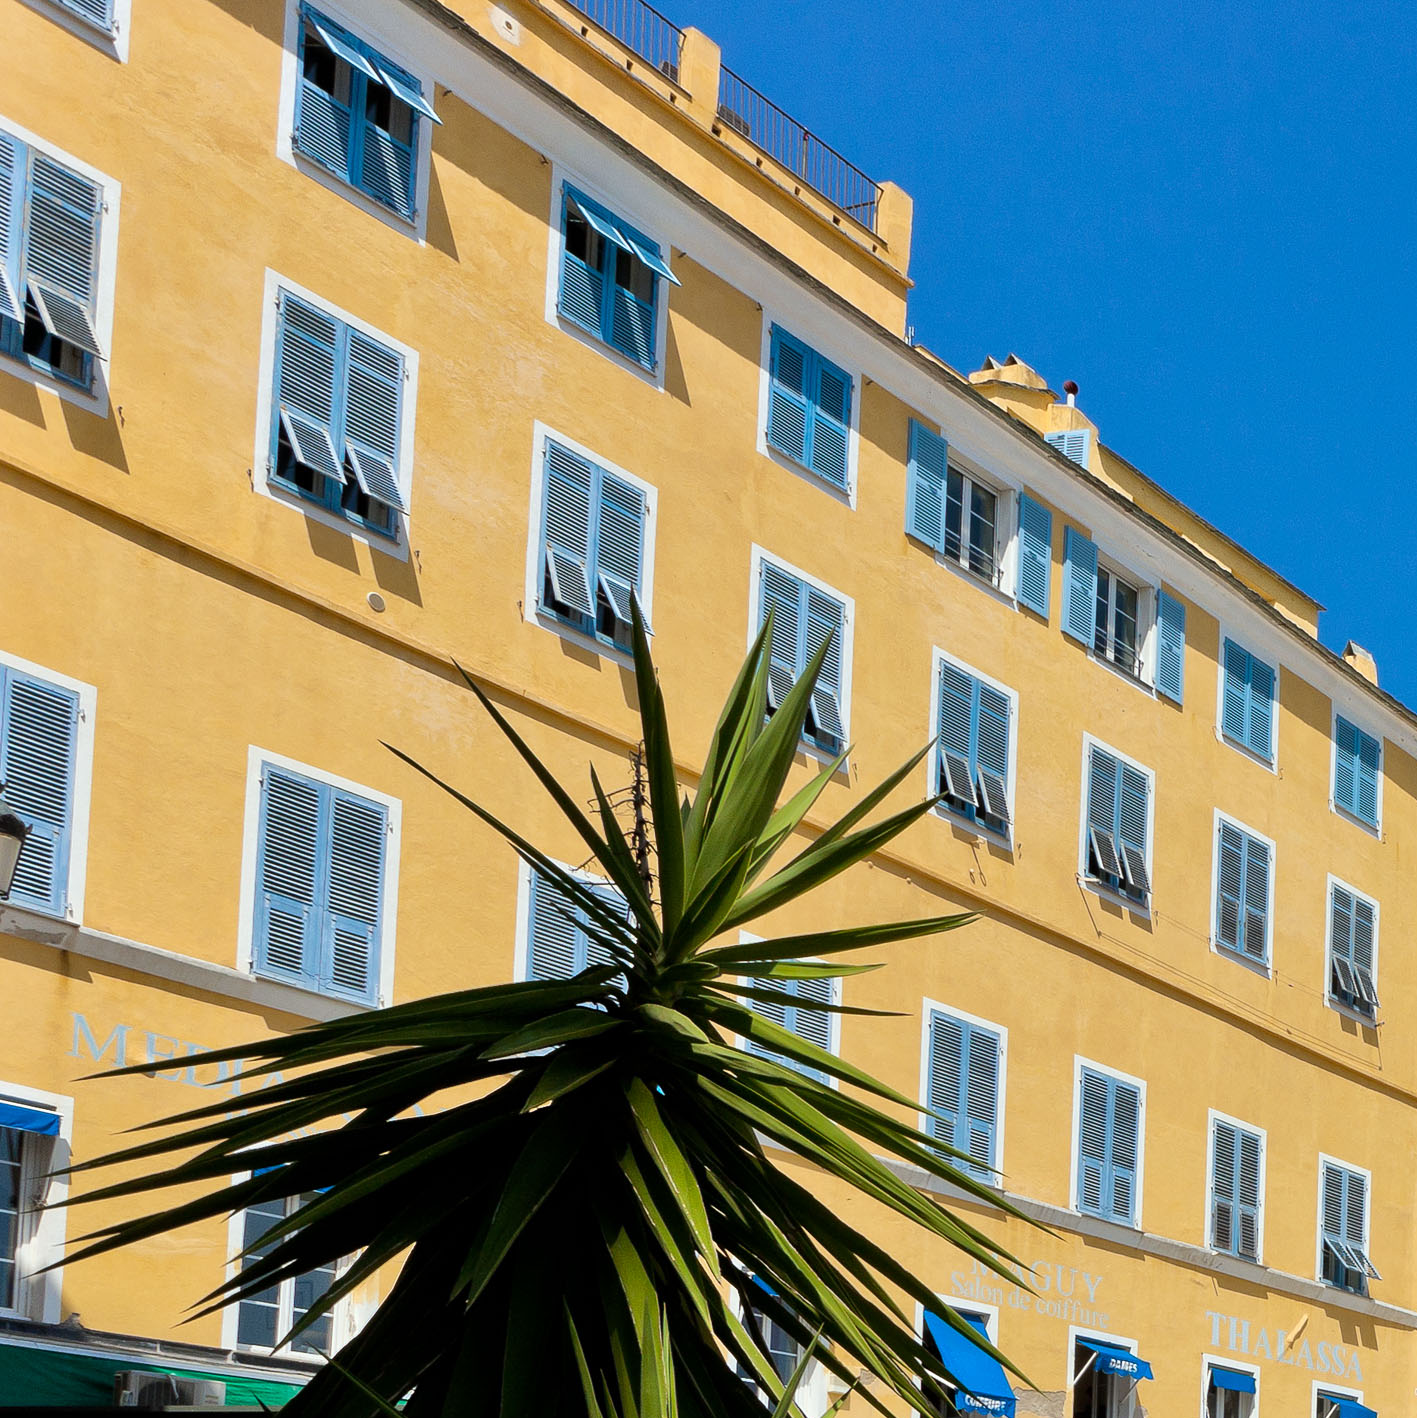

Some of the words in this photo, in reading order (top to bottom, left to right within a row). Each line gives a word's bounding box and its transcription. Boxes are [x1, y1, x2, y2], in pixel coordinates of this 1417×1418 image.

[951, 1271, 1003, 1305] Salon
[1008, 1287, 1031, 1310] de
[1035, 1298, 1111, 1328] coiffure
[1109, 1358, 1138, 1373] DAMES
[1205, 1311, 1364, 1382] THALASSA
